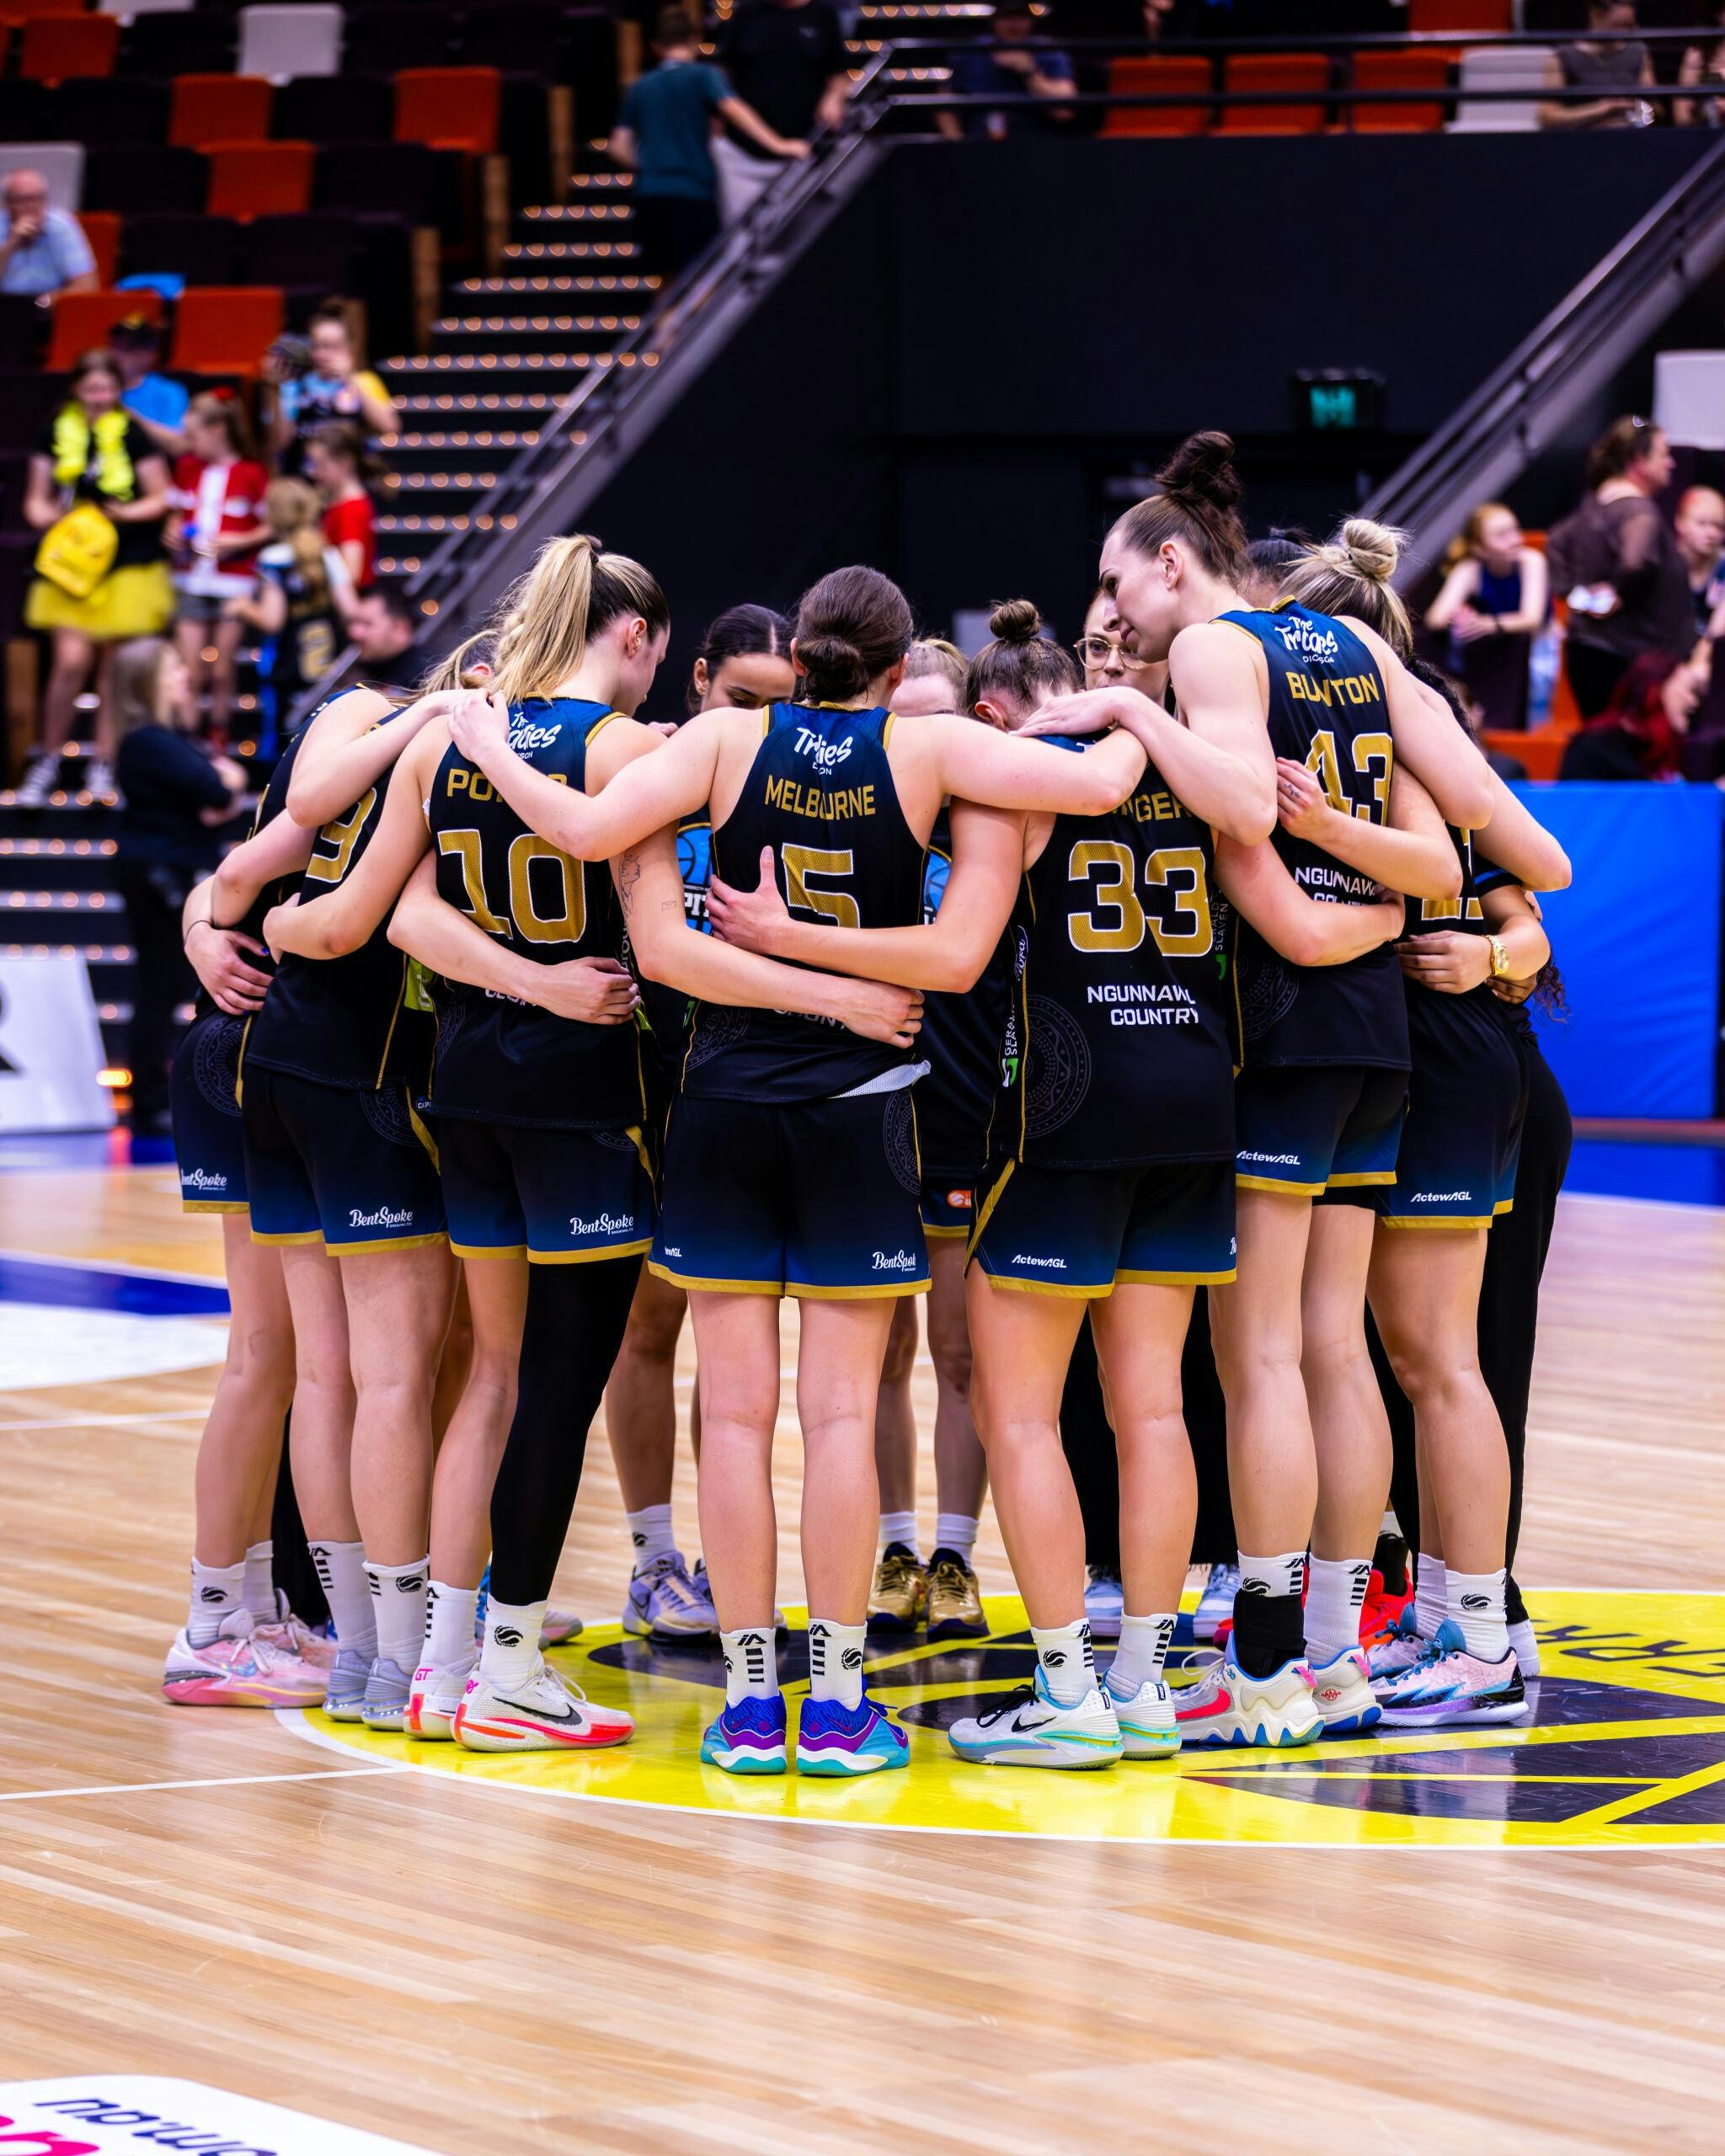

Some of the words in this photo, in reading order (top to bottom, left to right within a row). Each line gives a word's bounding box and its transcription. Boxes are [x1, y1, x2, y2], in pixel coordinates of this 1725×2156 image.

[1285, 671, 1380, 707] BUNTON
[436, 828, 587, 944] 10
[781, 842, 861, 928] 5
[1068, 840, 1214, 958] 33
[1236, 1150, 1300, 1166] ActewAGL
[1410, 1191, 1472, 1203] ActewAGL
[349, 1206, 413, 1228] BentSpoke
[569, 1213, 634, 1235] BentSpoke
[1011, 1254, 1067, 1268] ActewAGL
